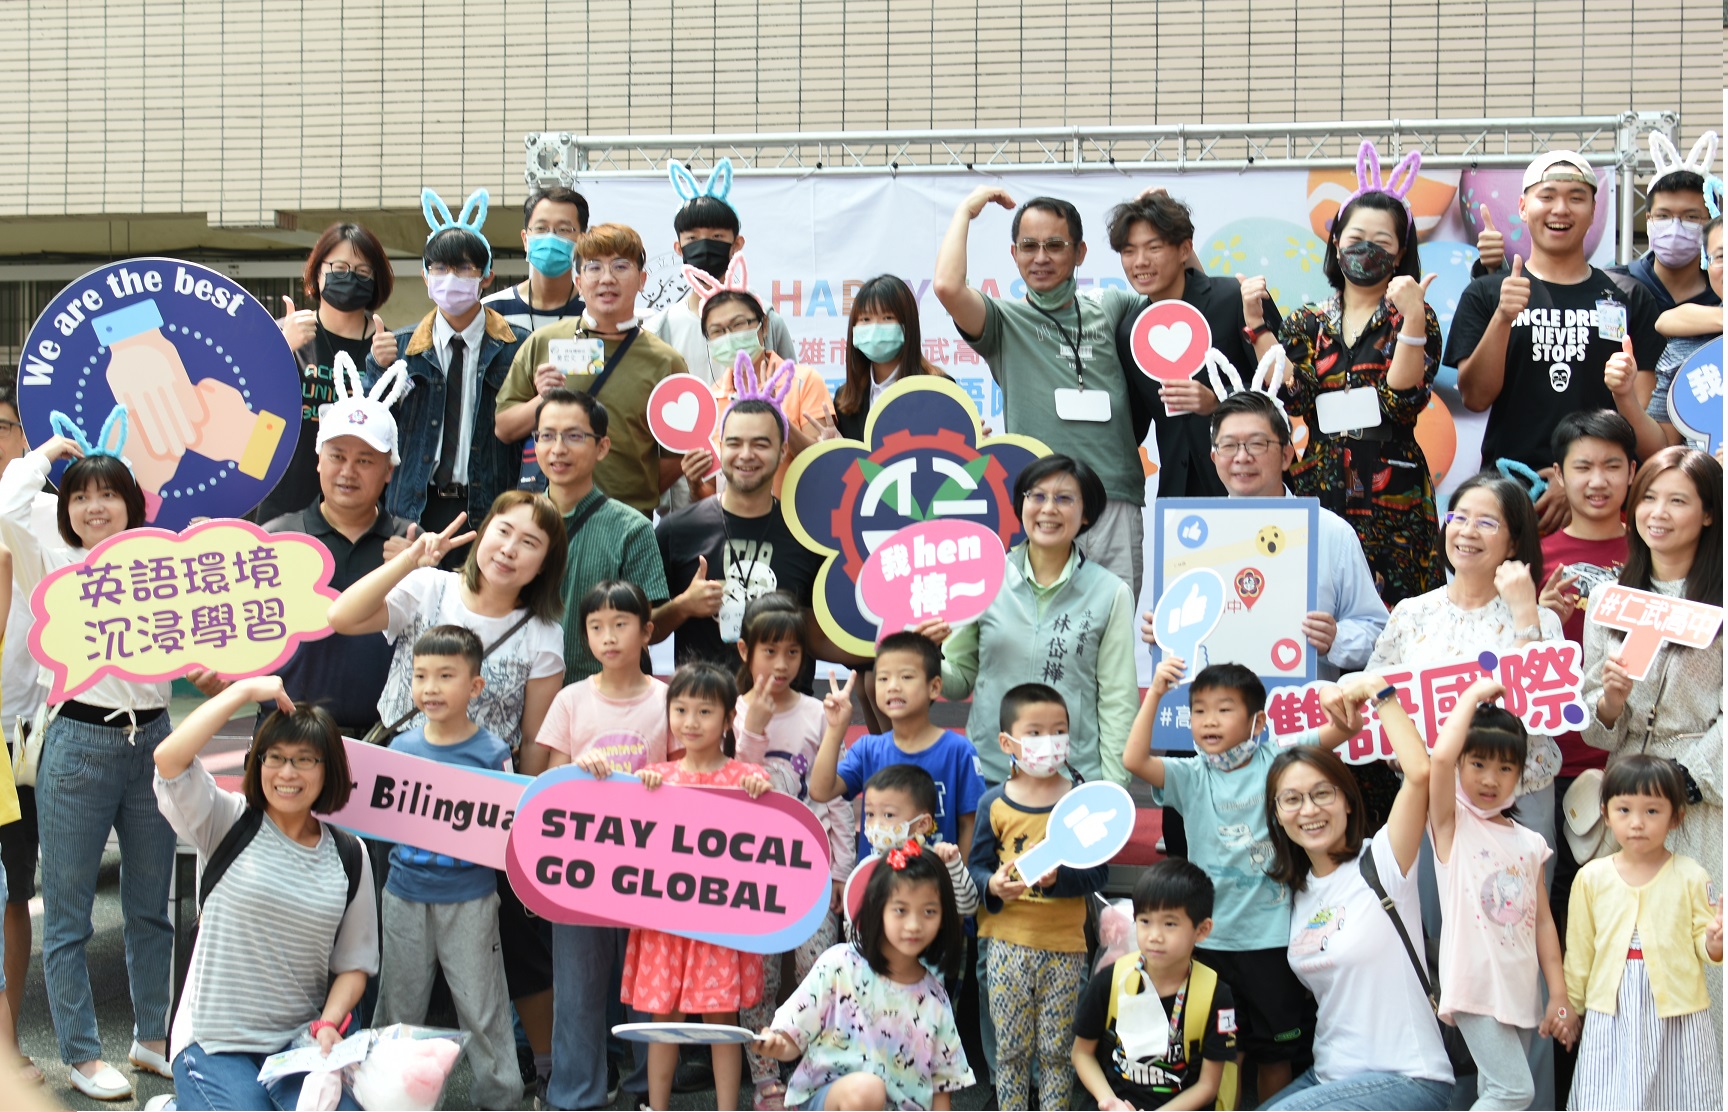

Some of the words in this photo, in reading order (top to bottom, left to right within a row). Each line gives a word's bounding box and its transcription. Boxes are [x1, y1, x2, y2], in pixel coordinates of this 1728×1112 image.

[22, 340, 61, 386] We
[54, 289, 103, 337] are
[106, 268, 163, 298] the
[174, 266, 245, 317] best
[1532, 326, 1589, 345] NEVER
[1532, 343, 1586, 362] STOPS
[76, 545, 282, 608] 英語環境
[84, 597, 287, 661] 沉浸學習
[541, 808, 657, 849] STAY
[671, 824, 812, 870] LOCAL
[535, 855, 596, 889] GO
[611, 865, 786, 915] GLOBAL
